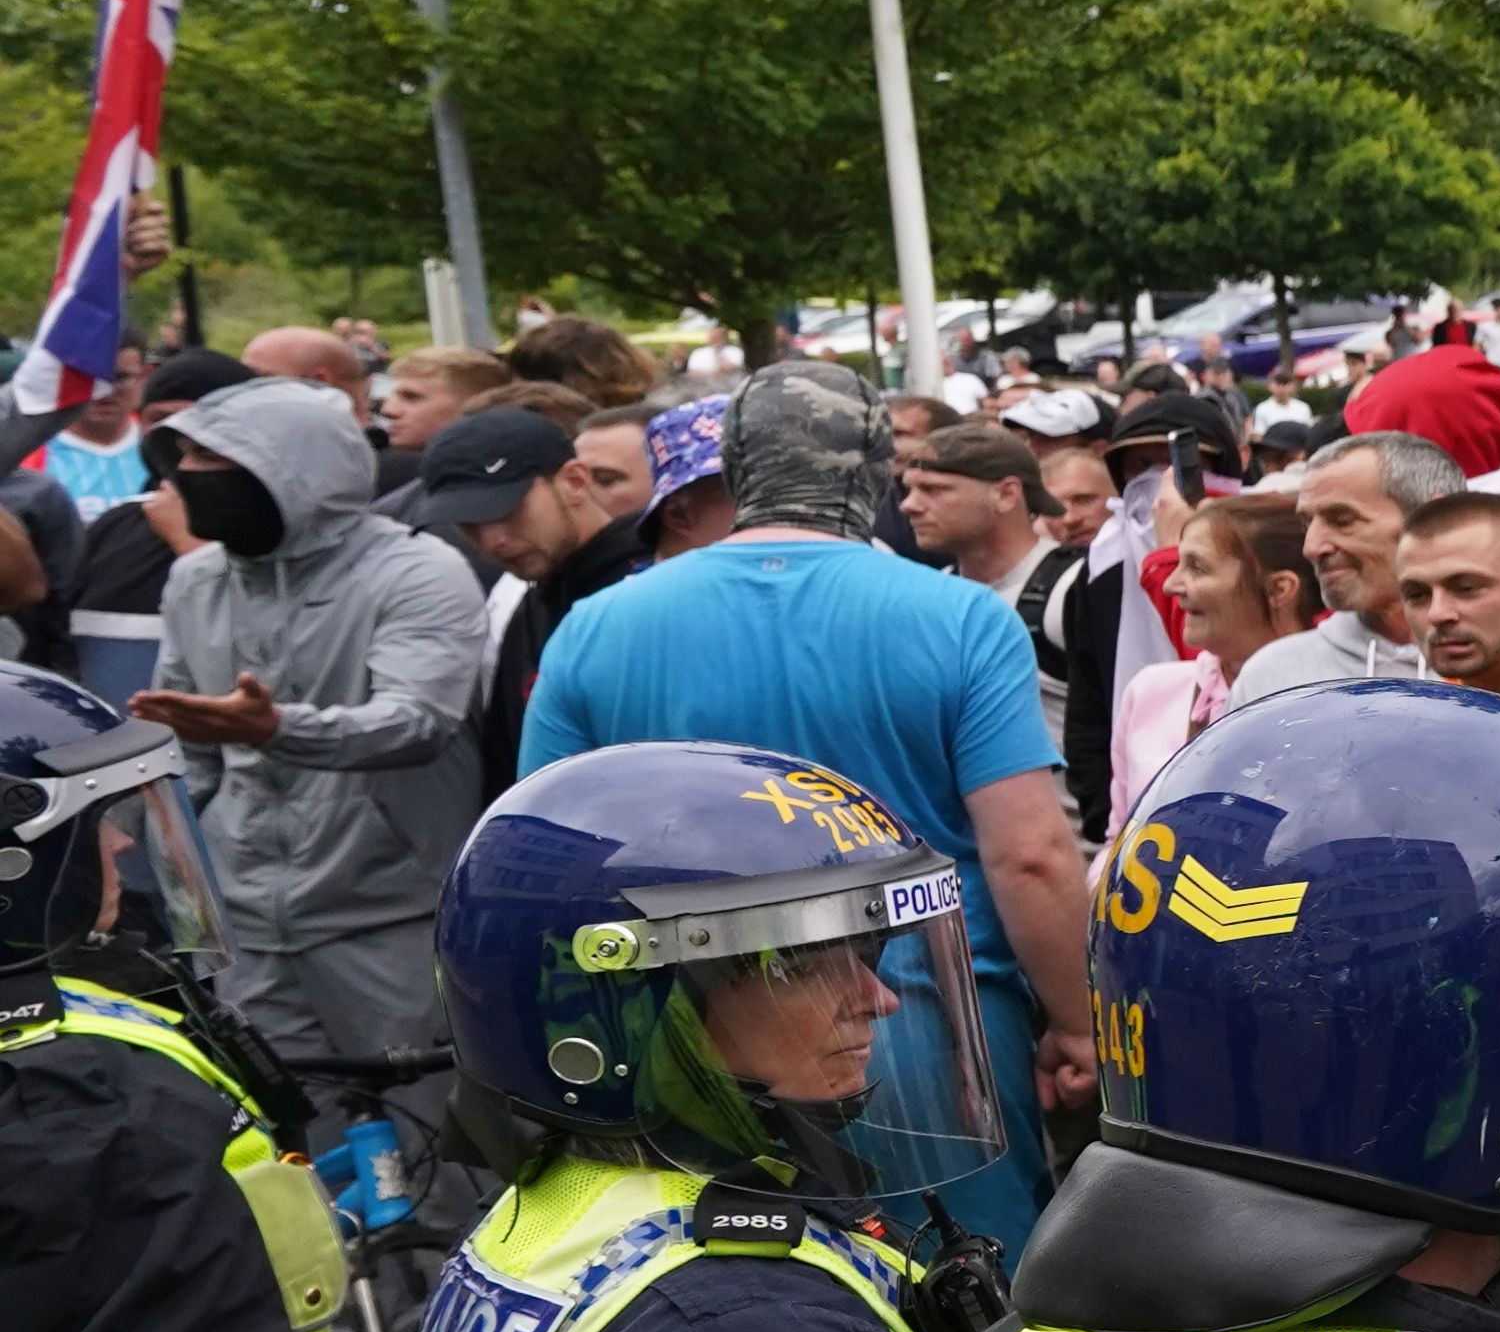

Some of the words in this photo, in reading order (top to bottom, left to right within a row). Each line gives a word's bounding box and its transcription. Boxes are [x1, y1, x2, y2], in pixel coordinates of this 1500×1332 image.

[812, 800, 902, 854] 2985
[892, 875, 958, 920] POLICE
[711, 1214, 789, 1231] 2985
